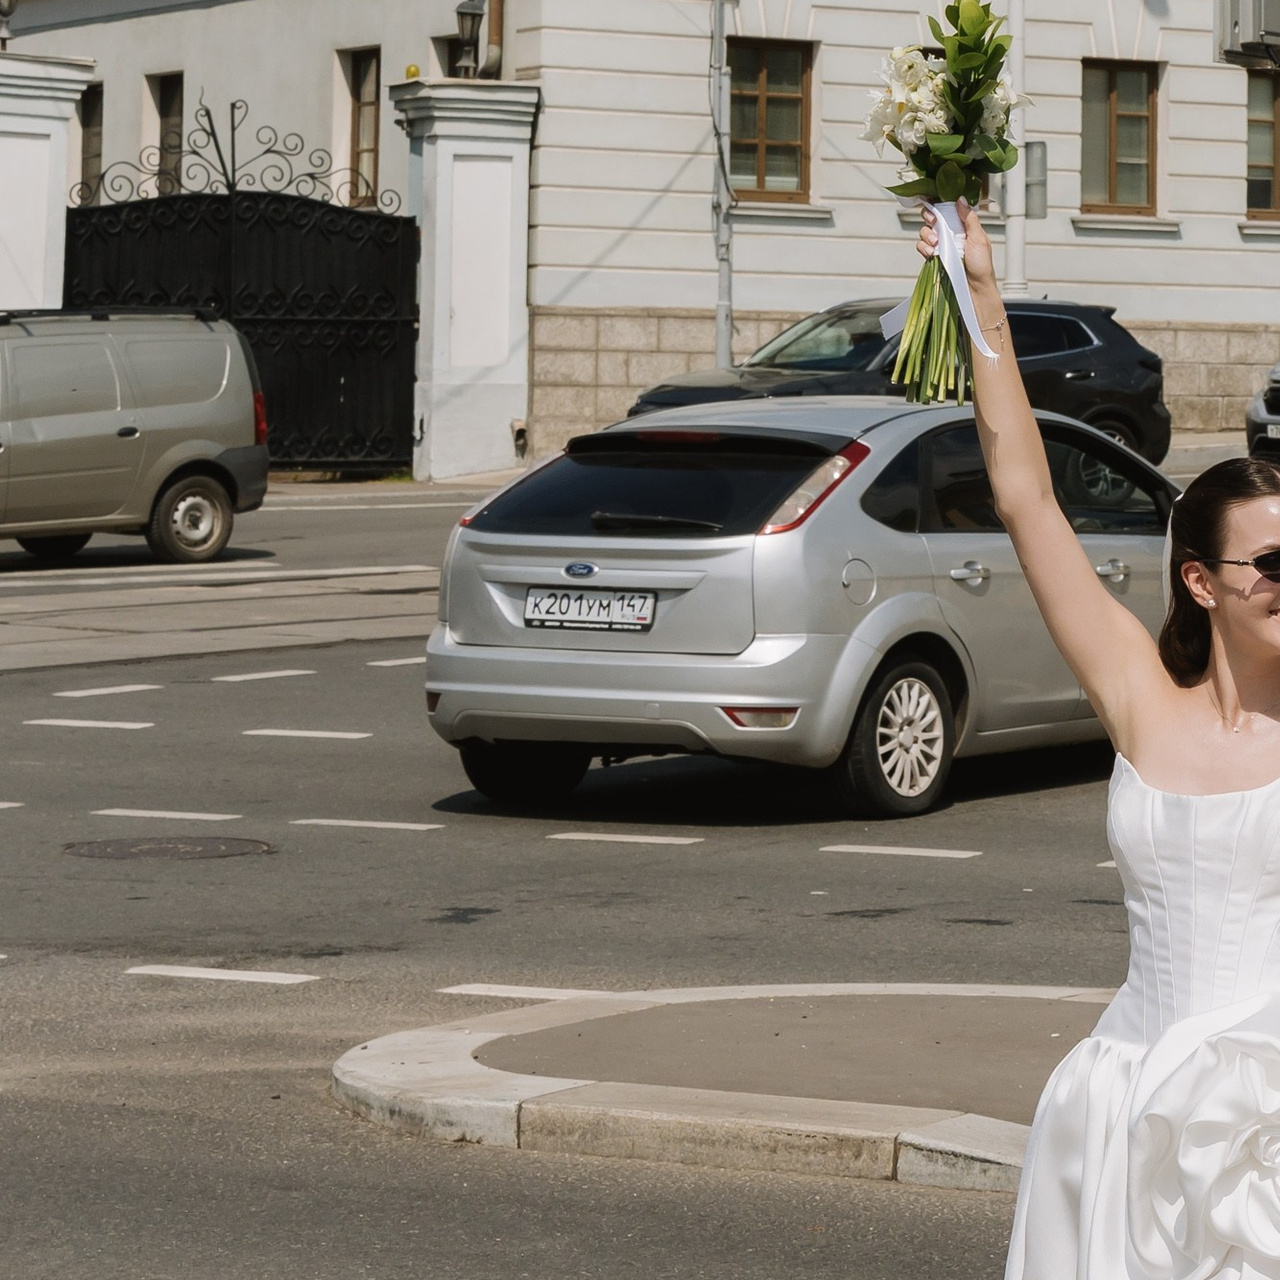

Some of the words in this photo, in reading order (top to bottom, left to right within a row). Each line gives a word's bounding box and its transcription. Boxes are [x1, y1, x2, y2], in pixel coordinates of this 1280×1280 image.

[569, 563, 590, 575] Ford
[532, 593, 610, 617] К201УМ
[616, 595, 648, 614] 147
